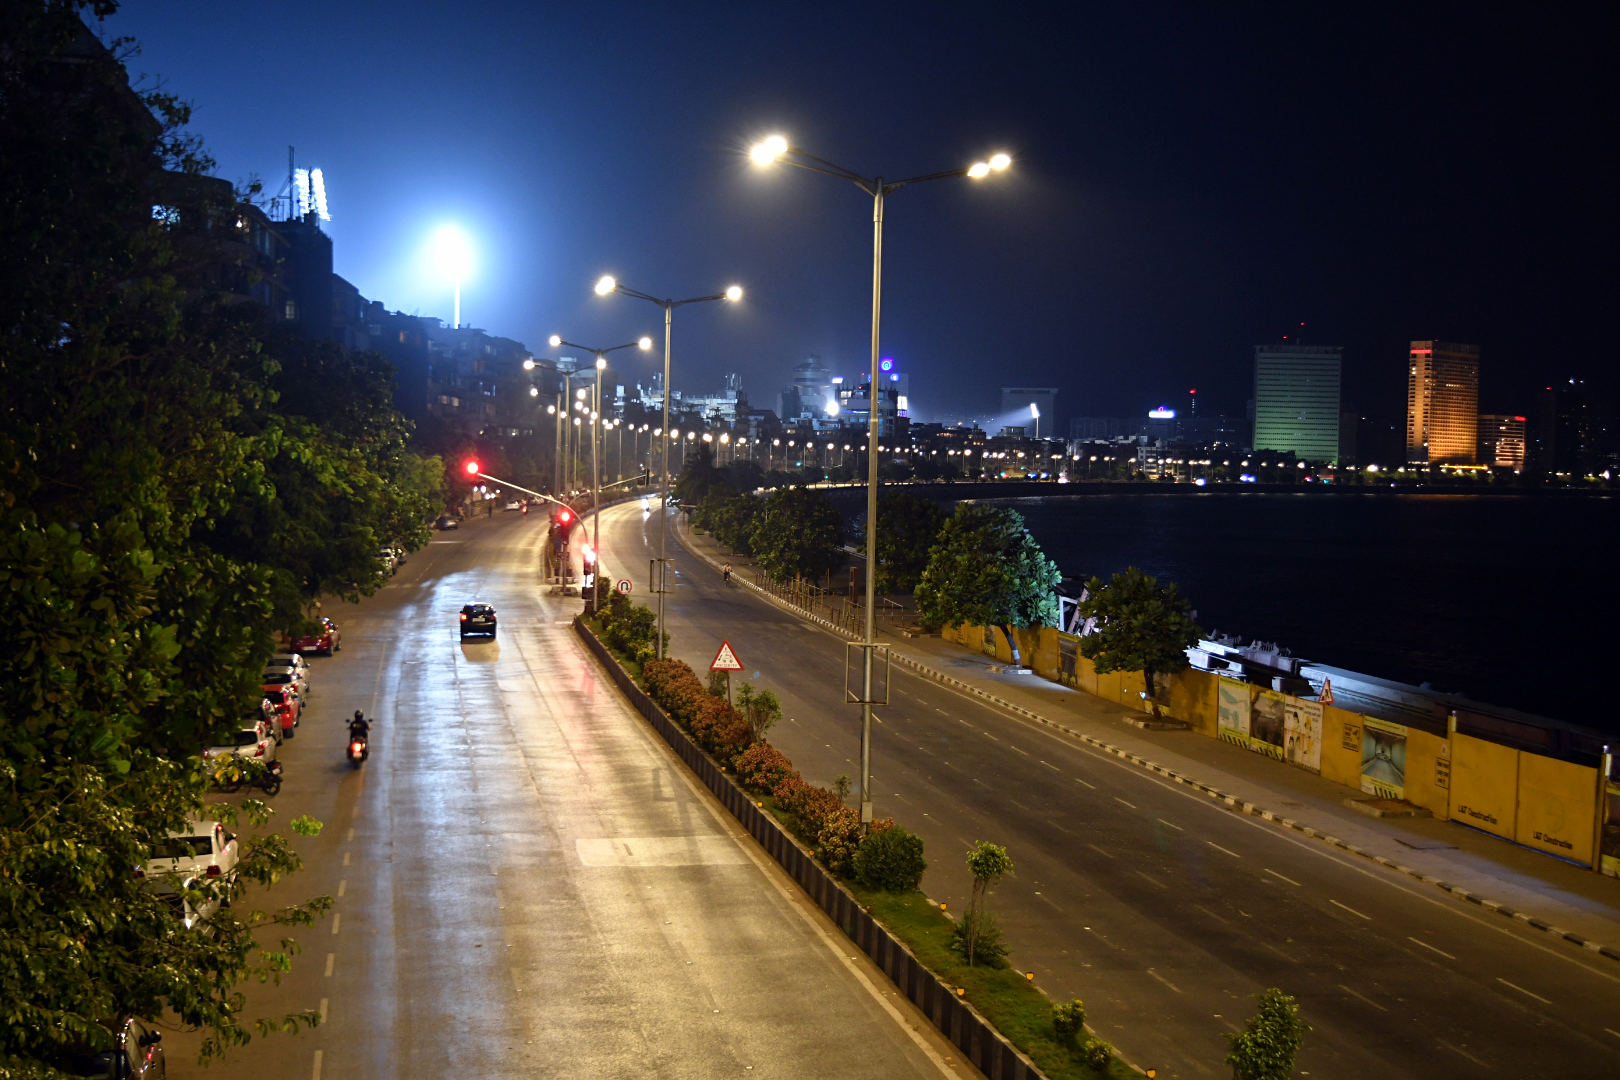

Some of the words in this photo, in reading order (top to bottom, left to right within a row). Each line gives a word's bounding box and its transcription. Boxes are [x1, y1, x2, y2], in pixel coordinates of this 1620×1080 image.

[1458, 804, 1467, 813] L&T
[1468, 807, 1497, 825] Construction
[1533, 830, 1542, 840] L&T
[1543, 834, 1573, 850] Construction
